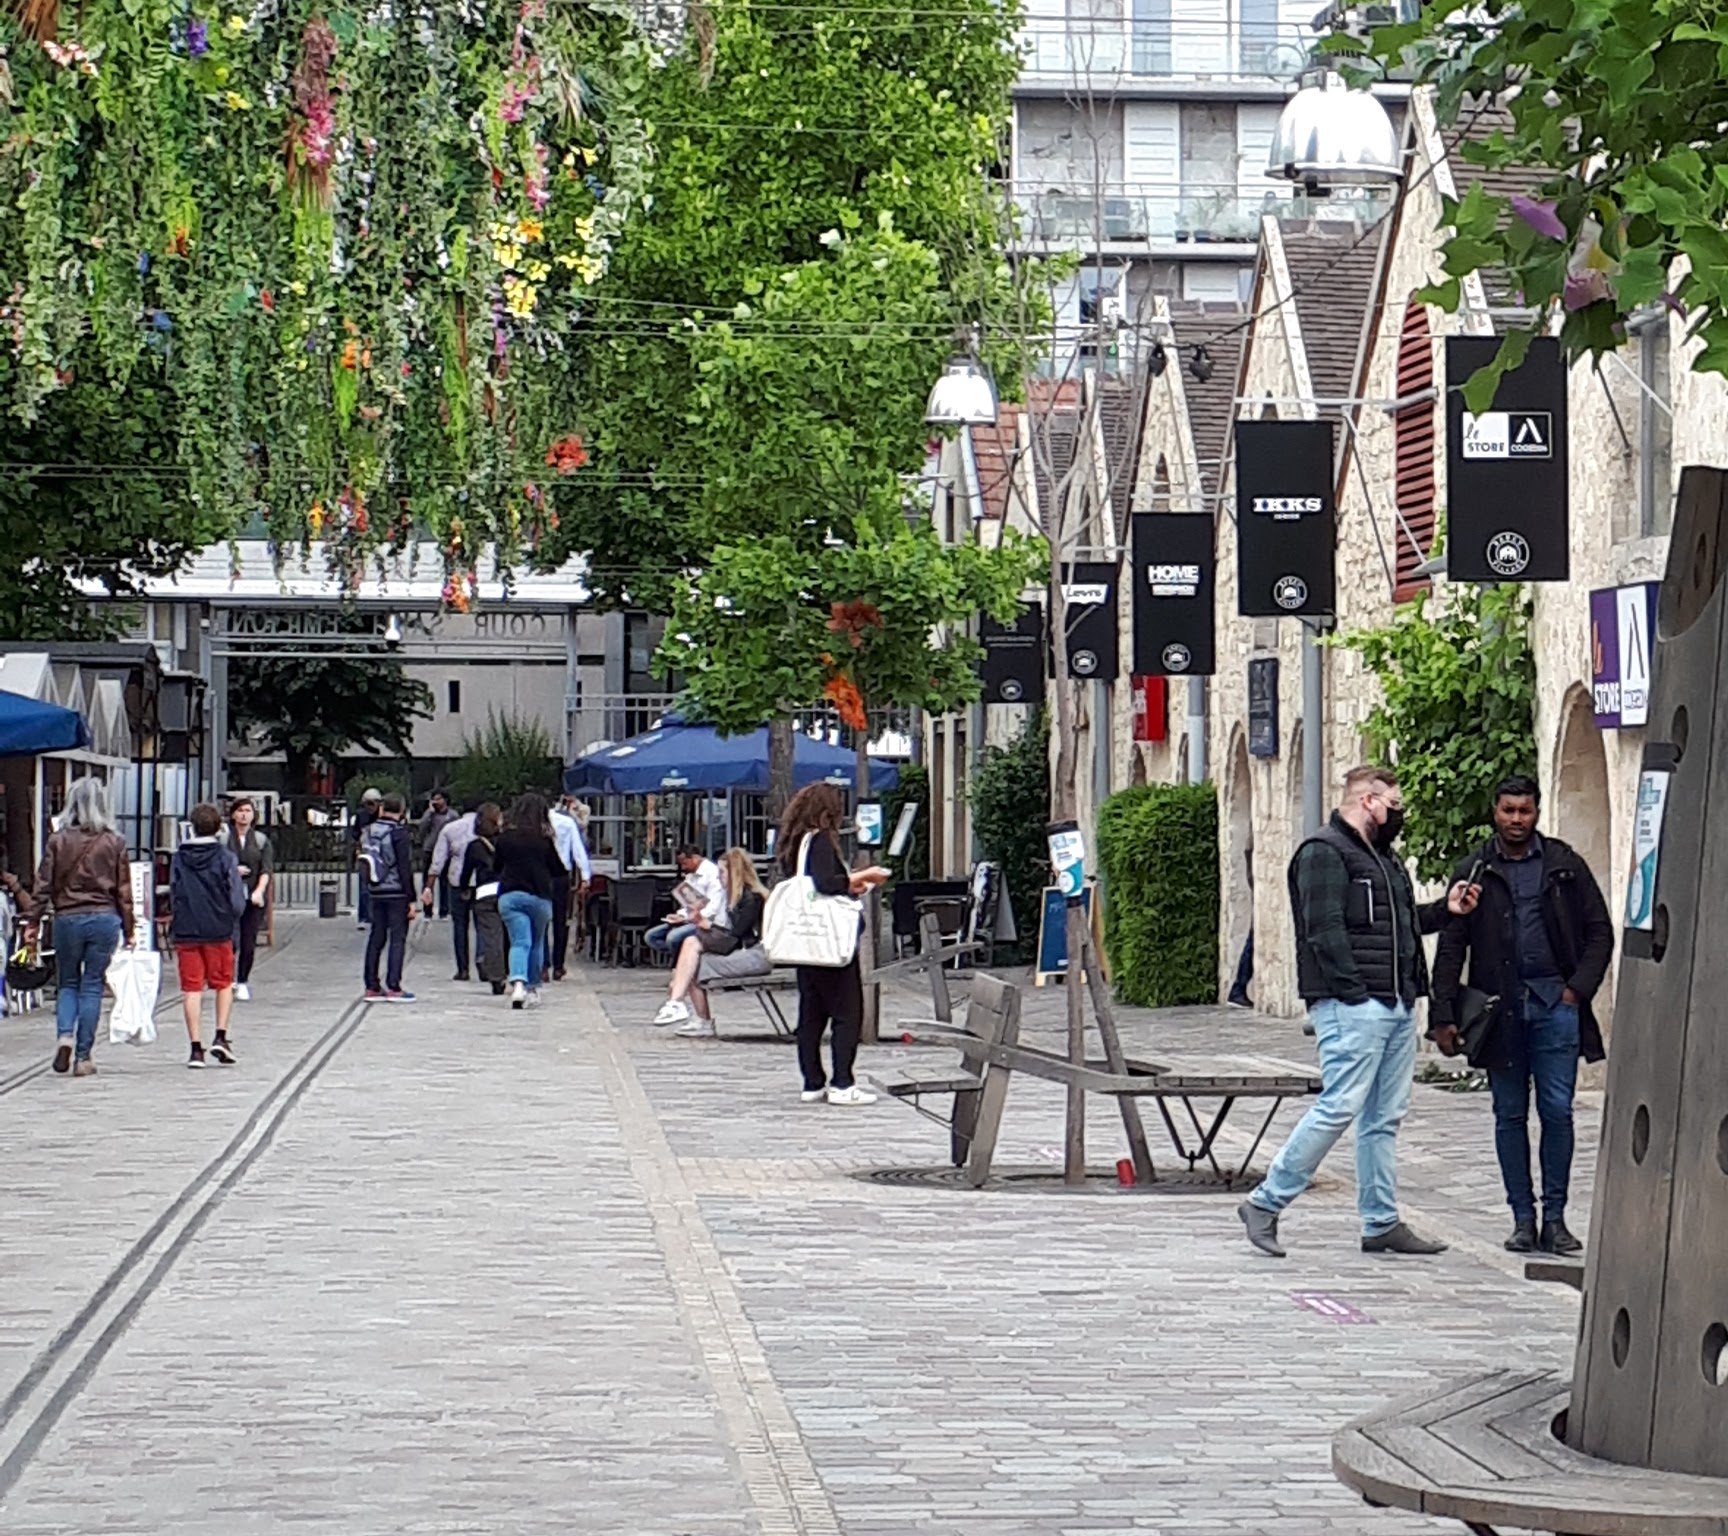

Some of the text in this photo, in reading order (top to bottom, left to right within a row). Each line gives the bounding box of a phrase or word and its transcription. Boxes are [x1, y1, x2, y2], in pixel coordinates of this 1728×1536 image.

[1467, 442, 1505, 453] STORE
[1253, 497, 1322, 513] IKKS
[1148, 565, 1199, 579] HOME
